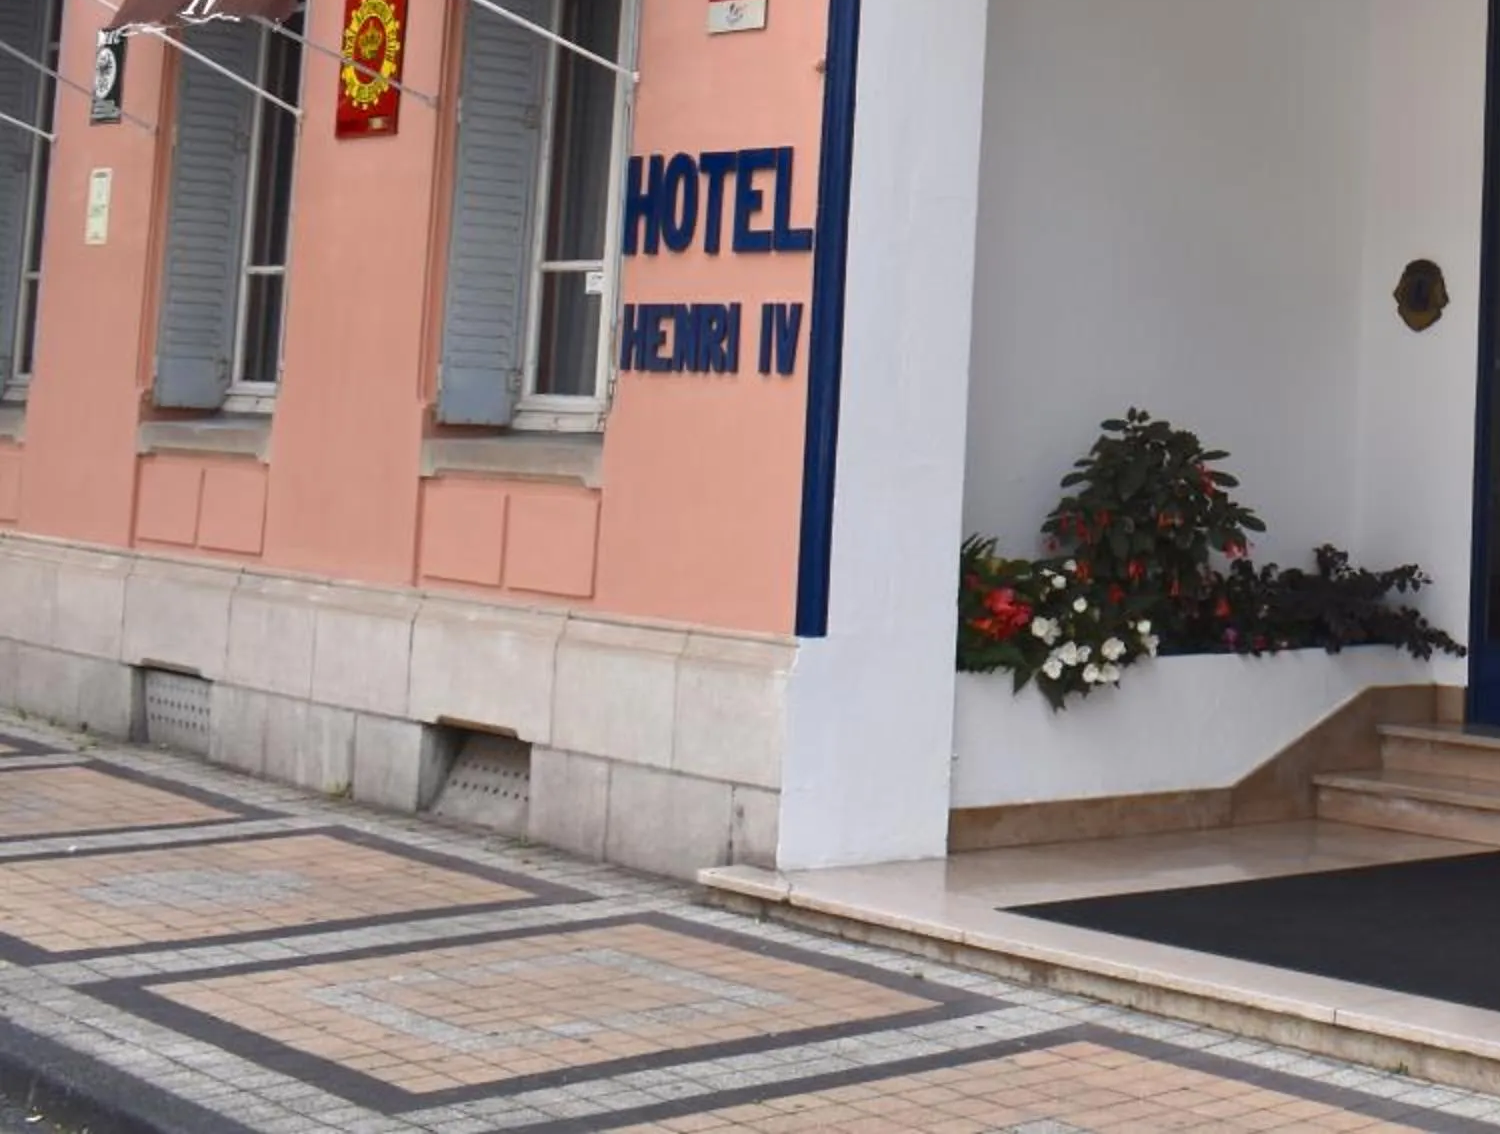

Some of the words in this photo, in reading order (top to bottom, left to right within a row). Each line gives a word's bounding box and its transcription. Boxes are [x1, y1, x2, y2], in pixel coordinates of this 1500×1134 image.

[622, 146, 814, 256] HOTEL
[620, 301, 742, 374] HENRI
[757, 302, 804, 376] IV
